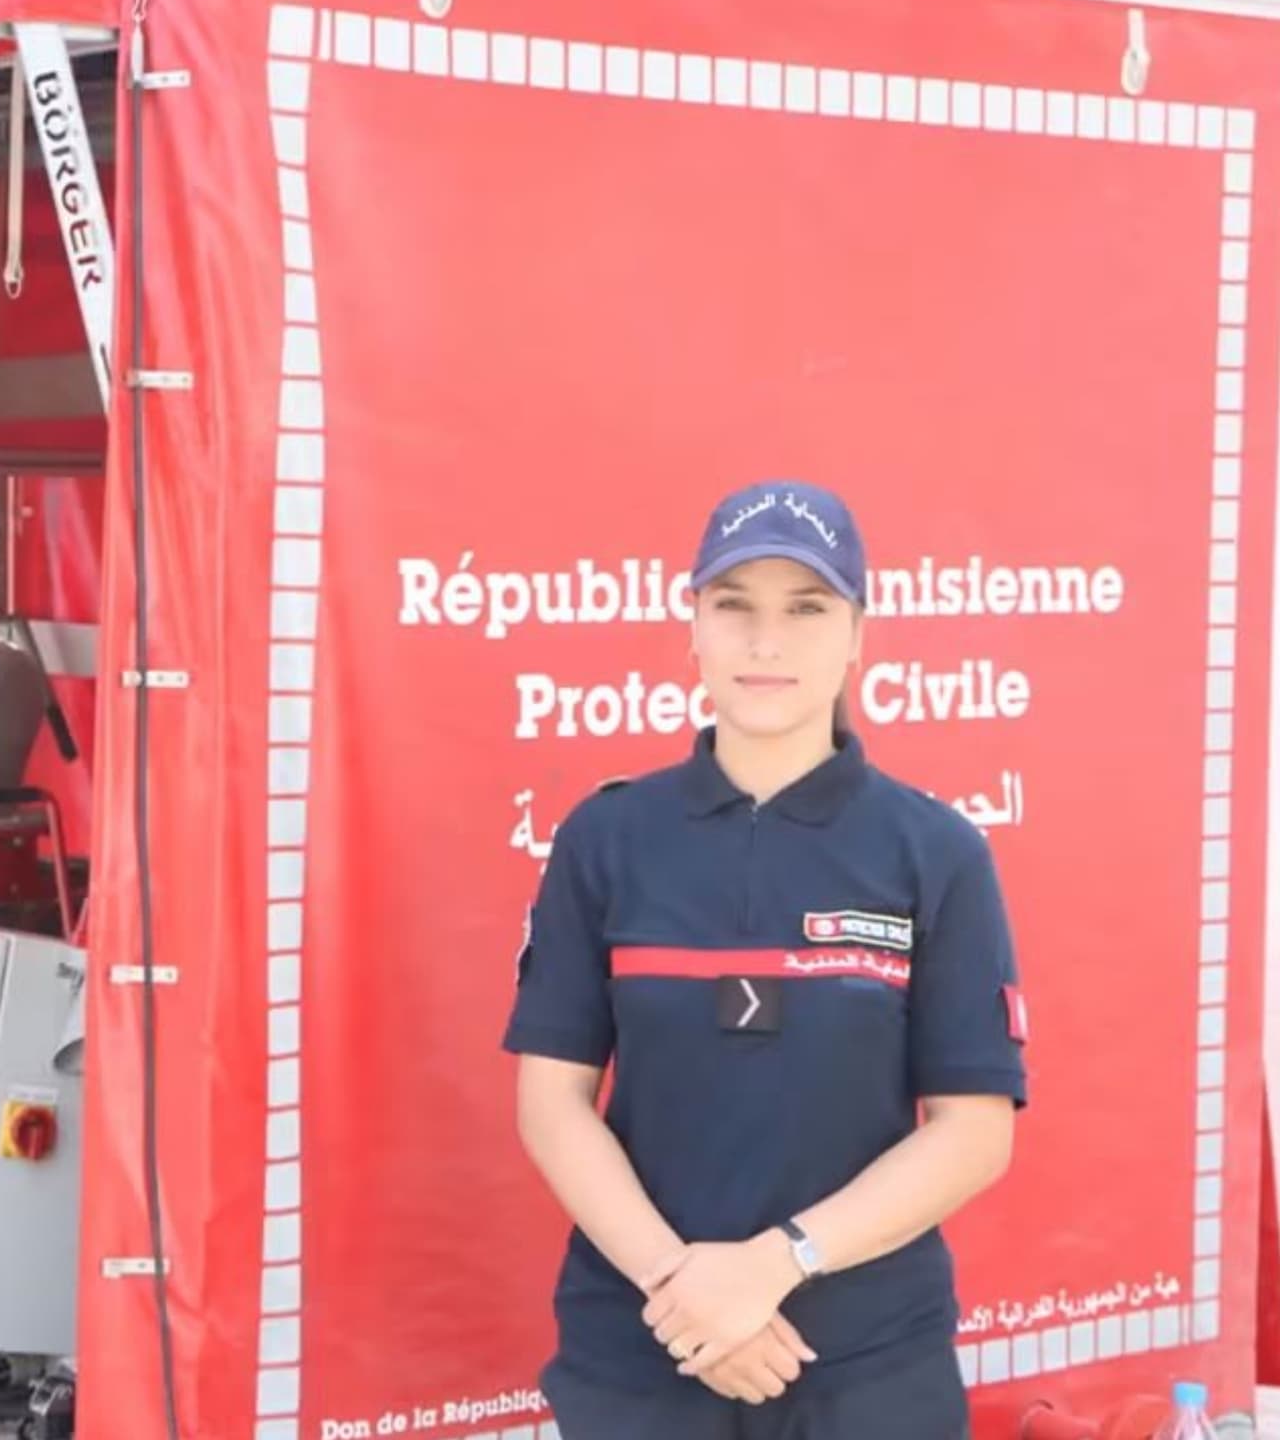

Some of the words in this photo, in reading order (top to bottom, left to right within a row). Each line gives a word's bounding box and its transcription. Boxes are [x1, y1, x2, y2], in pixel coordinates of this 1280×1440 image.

[33, 70, 104, 292] BÖRGER
[397, 549, 695, 639] Républi
[865, 555, 1124, 618] nisienne
[514, 670, 717, 740] Protec
[860, 658, 1032, 725] Civile
[321, 1418, 371, 1440] Don
[376, 1411, 408, 1437] de
[413, 1407, 437, 1429] la
[442, 1389, 548, 1426] Républiq
